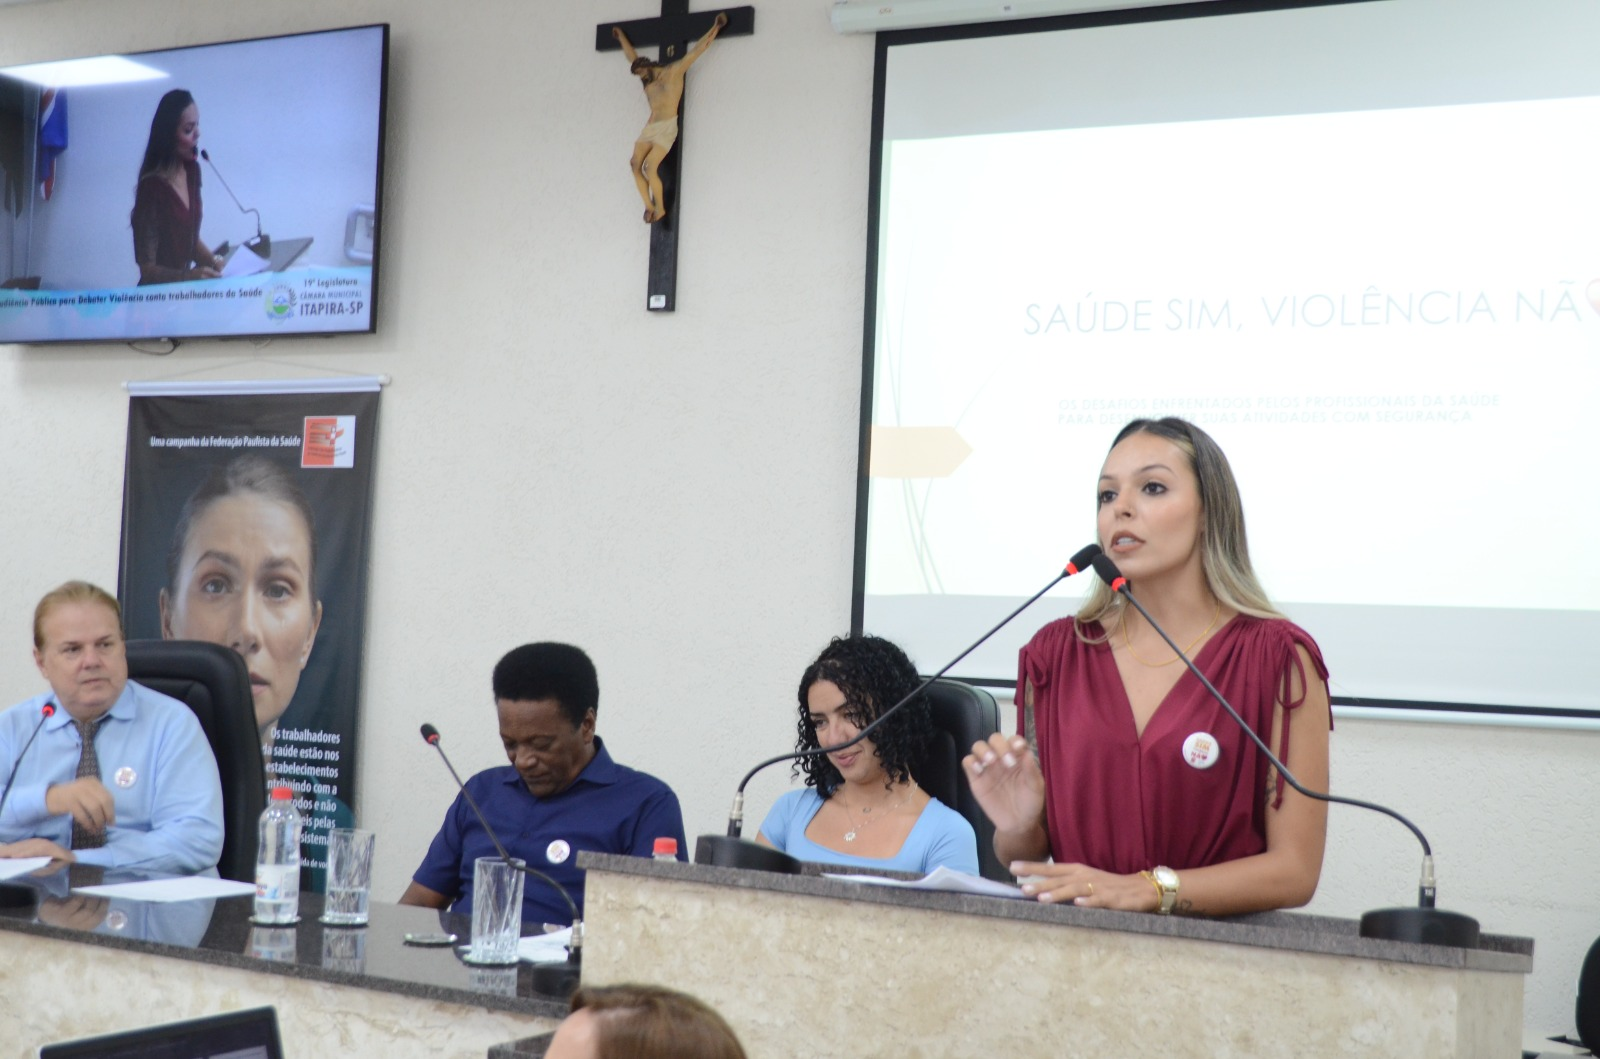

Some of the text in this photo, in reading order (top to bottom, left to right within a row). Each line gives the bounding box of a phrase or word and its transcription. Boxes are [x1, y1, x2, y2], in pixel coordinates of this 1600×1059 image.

[317, 276, 358, 288] Legislatura
[0, 297, 29, 308] udiência
[59, 297, 76, 307] para
[78, 294, 107, 304] Debater
[109, 293, 144, 303] Violência
[169, 289, 223, 301] trabalhadores
[226, 288, 236, 298] da
[239, 286, 263, 297] Saúde
[300, 289, 362, 300] CÂMARA MUNICIPAL
[300, 300, 364, 316] ITAPIRA-SP
[1023, 291, 1153, 335] SAÚDE
[1164, 298, 1243, 332] SIM,
[1261, 285, 1496, 328] VIOLÊNCIA
[1058, 391, 1501, 410] OS DESAFIOS ENFRENTADOS PELOS PROFISSIONAIS DA SAÚDE
[1058, 413, 1094, 425] PARA
[1202, 412, 1237, 424] SUAS
[1243, 411, 1327, 424] ATIVIDADES
[1331, 410, 1370, 423] COM
[1375, 410, 1472, 425] SEGURANÇA
[150, 435, 301, 450] Uma campanha da Federação Paulista da Saúde
[270, 726, 341, 744] Os trabalhadores
[262, 742, 340, 761] da saúde estão nos
[265, 761, 339, 778] estabelecimentos
[267, 778, 338, 796] ntribuindo com a
[290, 796, 337, 812] odos e não
[313, 815, 336, 830] pelas
